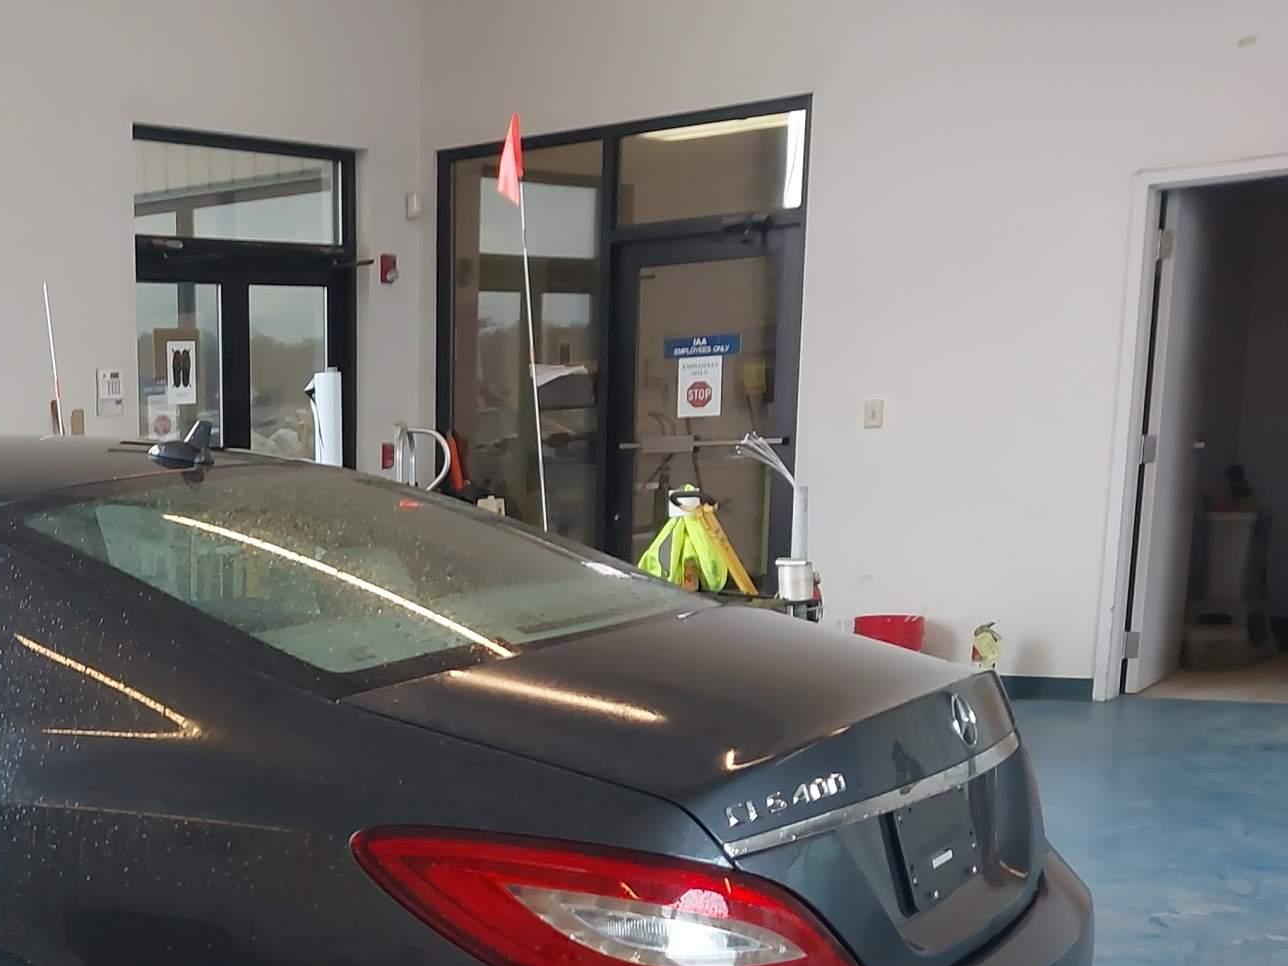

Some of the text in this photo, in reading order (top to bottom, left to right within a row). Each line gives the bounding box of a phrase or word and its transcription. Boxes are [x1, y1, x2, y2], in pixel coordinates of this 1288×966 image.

[693, 337, 708, 346] IAA
[673, 344, 730, 355] EMPLOYEES ONLY
[688, 388, 712, 401] STOP
